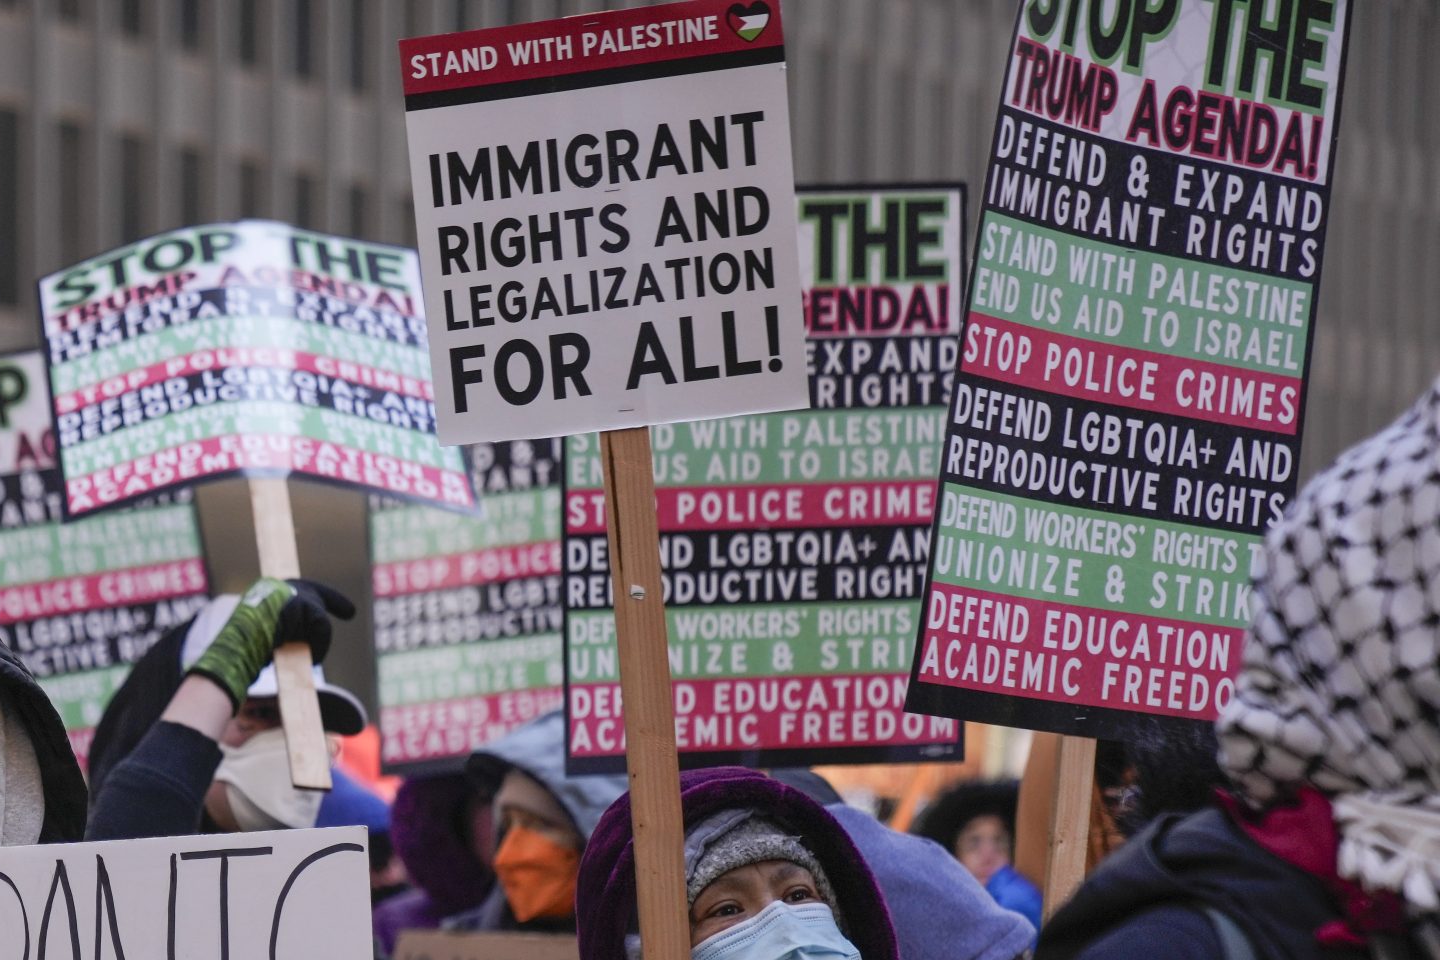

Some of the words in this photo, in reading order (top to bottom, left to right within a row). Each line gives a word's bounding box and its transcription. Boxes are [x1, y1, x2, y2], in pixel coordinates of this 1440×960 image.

[411, 46, 498, 79] STAND
[508, 36, 573, 67] WITH
[582, 15, 718, 57] PALESTINE
[1204, 0, 1337, 116] THE
[1011, 36, 1118, 134] TRUMP
[1125, 78, 1324, 182] AGENDA!
[429, 111, 764, 208] IMMIGRANT
[997, 115, 1107, 188] DEFEND
[1127, 155, 1149, 198] &
[1174, 163, 1323, 232] EXPAND
[438, 203, 630, 276] RIGHTS
[654, 186, 770, 248] AND
[799, 198, 949, 284] THE
[988, 163, 1166, 247] IMMIGRANT
[1186, 215, 1318, 278] RIGHTS
[52, 271, 197, 329] TRUMP
[53, 231, 241, 308] STOP
[284, 235, 411, 292] THE
[444, 247, 775, 331] LEGALIZATION
[982, 221, 1057, 277] STAND
[1069, 244, 1136, 295] WITH
[1149, 263, 1307, 328] PALESTINE
[449, 332, 592, 413] FOR
[625, 305, 782, 391] ALL!
[806, 341, 958, 374] EXPAND
[975, 267, 1020, 313] END
[1030, 282, 1062, 324] US
[1073, 295, 1124, 344] AID
[1141, 309, 1180, 347] TO
[1194, 316, 1299, 370] ISRAEL
[332, 396, 437, 434] RIGHT
[964, 322, 1032, 374] STOP
[1044, 339, 1159, 401] POLICE
[1176, 368, 1297, 425] CRIMES
[689, 417, 768, 450] WITH
[706, 452, 759, 481] AID
[779, 449, 821, 479] TO
[838, 446, 935, 477] ISRAE
[953, 382, 1051, 443] DEFEND
[1063, 407, 1217, 470] LGBTQIA+
[1225, 436, 1292, 484] AND
[677, 489, 803, 524] POLICE
[947, 434, 1159, 511] REPRODUCTIVE
[1173, 480, 1284, 529] RIGHTS
[567, 535, 693, 572] DEND
[709, 530, 876, 568] LGBTQIA+
[935, 535, 1082, 597] UNIONIZE
[1105, 565, 1125, 603] &
[941, 490, 1017, 539] DEFEND
[1023, 506, 1146, 559] WORKERS'
[1152, 528, 1237, 573] RIGHTS
[568, 567, 818, 607] REDUCTIVE
[675, 608, 808, 641] WORKERS'
[818, 606, 911, 636] RIGHTS
[570, 642, 748, 678] UNNIZE
[772, 642, 794, 671] &
[920, 635, 1081, 697] ACADEMIC
[927, 590, 1029, 645] DEFEND
[1043, 609, 1230, 673] EDUCATION
[570, 712, 758, 752] ACEMIC
[780, 711, 954, 743] FREEDOM
